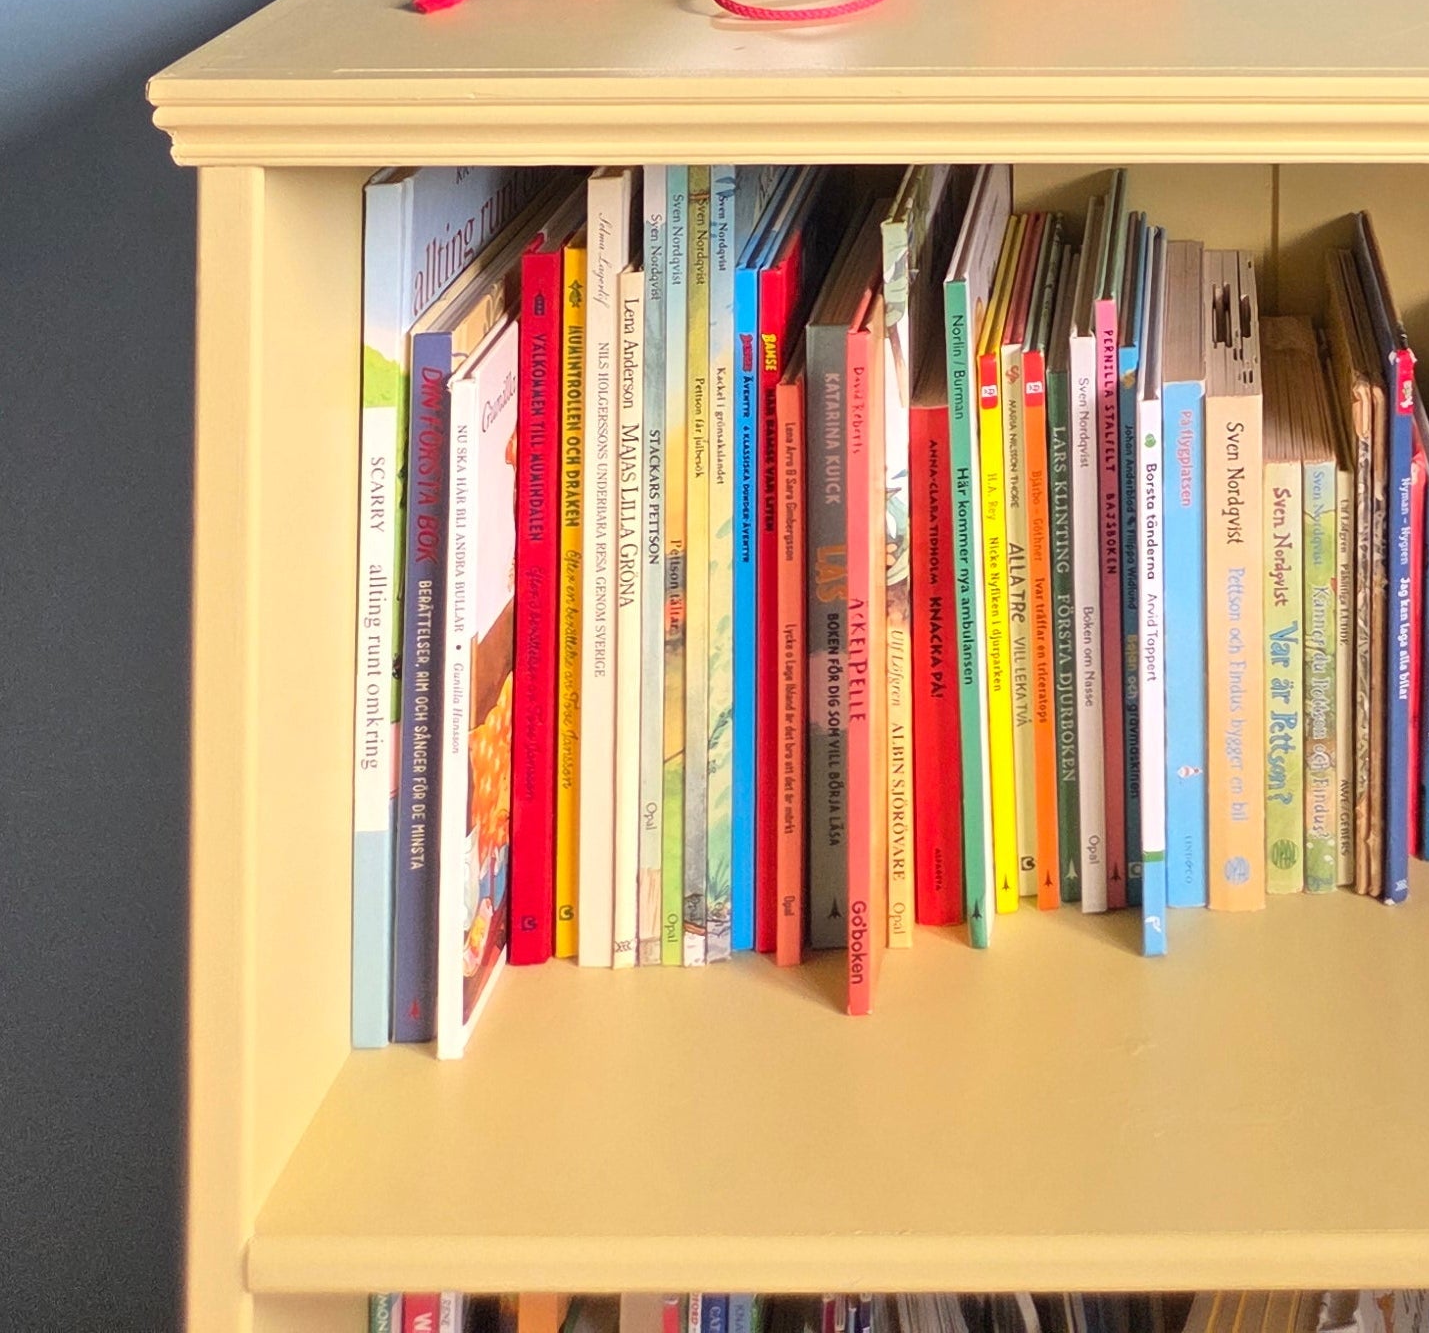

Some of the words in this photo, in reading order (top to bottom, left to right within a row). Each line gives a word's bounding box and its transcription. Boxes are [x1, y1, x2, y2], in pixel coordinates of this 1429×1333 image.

[651, 214, 662, 240] Sven
[648, 246, 662, 300] Nordqvist
[623, 299, 640, 334] Lena
[952, 315, 965, 357] Norlin
[530, 334, 548, 416] VÄLKOMMEN
[598, 342, 611, 368] NILS
[622, 339, 639, 408] Anderson
[1104, 330, 1115, 398] PERNILLA
[567, 326, 583, 430] MUMINTROLLEN
[853, 367, 865, 398] David
[953, 371, 966, 420] Burman
[1079, 377, 1090, 407] Sven
[596, 374, 610, 458] HOLGERSSONS
[825, 374, 841, 449] KATARINA
[853, 403, 865, 454] Roberts
[1182, 411, 1194, 426] På
[456, 425, 468, 443] NU
[530, 423, 545, 448] TILL
[566, 437, 581, 463] OCH
[620, 425, 640, 482] MAJAS
[1053, 427, 1066, 473] LARS
[1079, 412, 1091, 469] Nordqvist
[1104, 405, 1115, 472] STALFELT
[1226, 422, 1244, 461] Sven
[456, 448, 468, 473] SKA
[648, 430, 661, 499] STACKARS
[825, 455, 841, 505] KUICK
[929, 440, 940, 521] ANNA-CLARA
[956, 468, 969, 497] Här
[1178, 429, 1195, 506] flygplatsen
[370, 457, 385, 532] SCARRY
[456, 478, 470, 504] HÄR
[528, 454, 545, 540] MUMINDALEN
[564, 470, 580, 526] DRAKEN
[596, 464, 608, 538] UNDERBARA
[1146, 464, 1158, 510] Borsta
[1222, 467, 1245, 544] Nordqvist
[1273, 488, 1292, 528] Sven
[455, 509, 467, 528] BLI
[619, 488, 639, 538] LILLA
[648, 504, 660, 564] PETTSON
[958, 501, 971, 563] kommer
[1055, 481, 1068, 574] KLINTING
[1106, 493, 1116, 574] BAJSBOKEN
[415, 514, 439, 564] BOK
[454, 534, 467, 576] ANDRA
[595, 543, 608, 573] RESA
[930, 525, 939, 584] TIDHOLM
[990, 538, 1001, 569] Nicke
[1146, 514, 1158, 580] tänderna
[619, 544, 639, 607] GRÖNA
[957, 568, 970, 593] nya
[1009, 543, 1026, 587] ALLA
[1269, 533, 1292, 606] Nordqvist
[1398, 577, 1411, 597] Jag
[365, 564, 387, 628] allting
[454, 582, 467, 632] BULLAR
[595, 577, 607, 621] GENOM
[988, 573, 1001, 617] Nyfiken
[1035, 578, 1045, 599] Ivar
[1146, 593, 1158, 627] Arvid
[1228, 567, 1246, 622] Pettson
[1400, 600, 1410, 621] kan
[415, 580, 434, 667] BERÄTTELSER,
[827, 613, 840, 654] BOKEN
[891, 631, 904, 651] Ulf
[930, 596, 943, 666] KNACKA
[961, 597, 975, 685] ambulansen
[1036, 604, 1047, 641] träffar
[1058, 594, 1076, 665] FÖRSTA
[1083, 606, 1095, 644] Boken
[1229, 628, 1246, 654] och
[1270, 621, 1299, 667] Var
[1397, 624, 1410, 647] laga
[367, 636, 384, 676] runt
[594, 626, 607, 677] SVERIGE
[827, 659, 843, 682] FÖR
[989, 629, 1003, 692] djurparken
[1013, 637, 1026, 664] VILL
[1038, 645, 1045, 659] en
[1085, 648, 1093, 667] om
[1400, 651, 1410, 671] alla
[415, 673, 431, 691] RIM
[452, 662, 464, 704] Gunilla
[828, 686, 840, 707] DIG
[888, 654, 904, 706] Löfgren
[931, 672, 946, 698] PÅ!
[1014, 668, 1027, 701] LEKA
[1035, 662, 1048, 723] triceratops
[1085, 672, 1096, 707] Nasse
[1230, 661, 1247, 712] Findus
[1271, 677, 1294, 704] är
[1400, 674, 1410, 700] bilar
[363, 682, 384, 770] omkring
[414, 697, 430, 721] OCH
[451, 708, 463, 754] Hansson
[828, 711, 840, 737] SOM
[1015, 703, 1032, 728] TVÅ
[1059, 673, 1075, 782] DJURBOKEN
[412, 725, 432, 773] SÅNGER
[828, 740, 840, 767] VILL
[891, 723, 904, 774] ALBIN
[1226, 719, 1247, 771] bygger
[1268, 710, 1299, 805] Pettson?
[411, 777, 430, 799] FÖR
[827, 772, 845, 811] BÖRJA
[1230, 777, 1242, 794] en
[411, 804, 427, 820] DE
[828, 816, 844, 847] LÄSA
[890, 779, 909, 881] SJÖRÖVARE
[1231, 802, 1248, 820] bil
[410, 824, 427, 870] MINSTA
[888, 902, 905, 934] Opal
[851, 900, 867, 985] Go'boken
